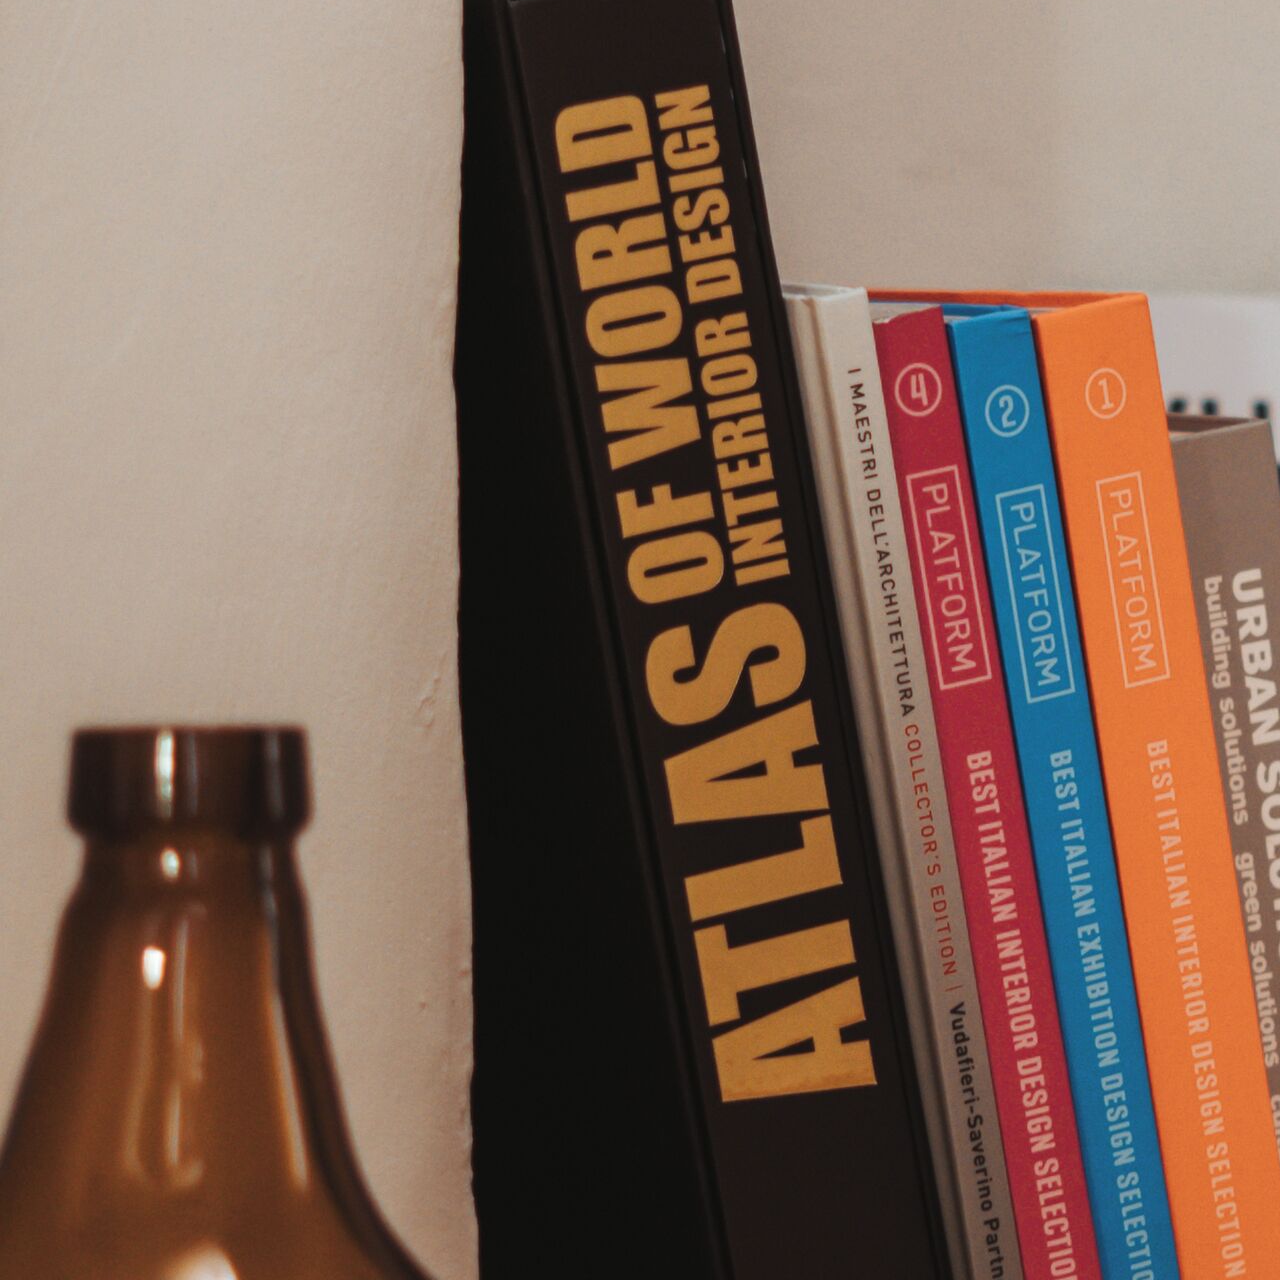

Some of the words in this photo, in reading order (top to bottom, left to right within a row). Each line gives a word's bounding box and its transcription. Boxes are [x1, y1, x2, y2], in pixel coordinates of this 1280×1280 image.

[655, 85, 742, 304] DESIGN
[555, 94, 702, 471] WORLD
[695, 311, 790, 586] INTERIOR
[910, 373, 929, 406] 4
[998, 396, 1016, 427] 2
[1099, 378, 1113, 411] 1
[616, 483, 724, 604] OF
[922, 483, 977, 673] PLATFORM
[1009, 501, 1061, 688] PLATFORM
[1109, 488, 1158, 673] PLATFORM
[850, 384, 879, 480] MAESTRI
[867, 488, 916, 718] DELL'ARCHITETTURA
[905, 724, 942, 877] COLLECTOR'S
[931, 885, 958, 977] EDITION
[950, 1001, 993, 1212] Vudafieri-Saverino
[966, 750, 1000, 815] BEST
[1049, 749, 1080, 813] BEST
[1147, 739, 1175, 802] BEST
[1204, 575, 1232, 690] building
[1219, 696, 1249, 826] solutions
[1235, 851, 1262, 933] green
[1250, 939, 1280, 1068] solutions
[646, 602, 877, 1103] ATLAS
[979, 821, 1018, 923] ITALIAN
[1060, 815, 1097, 919] ITALIAN
[1158, 804, 1191, 910] ITALIAN
[996, 928, 1038, 1050] INTERIOR
[1078, 920, 1120, 1068] EXHIBITION
[1172, 912, 1210, 1035] INTERIOR
[1016, 1055, 1055, 1154] DESIGN
[1099, 1071, 1135, 1166] DESIGN
[1191, 1040, 1226, 1141] DESIGN
[1206, 1143, 1247, 1278] SELECTION
